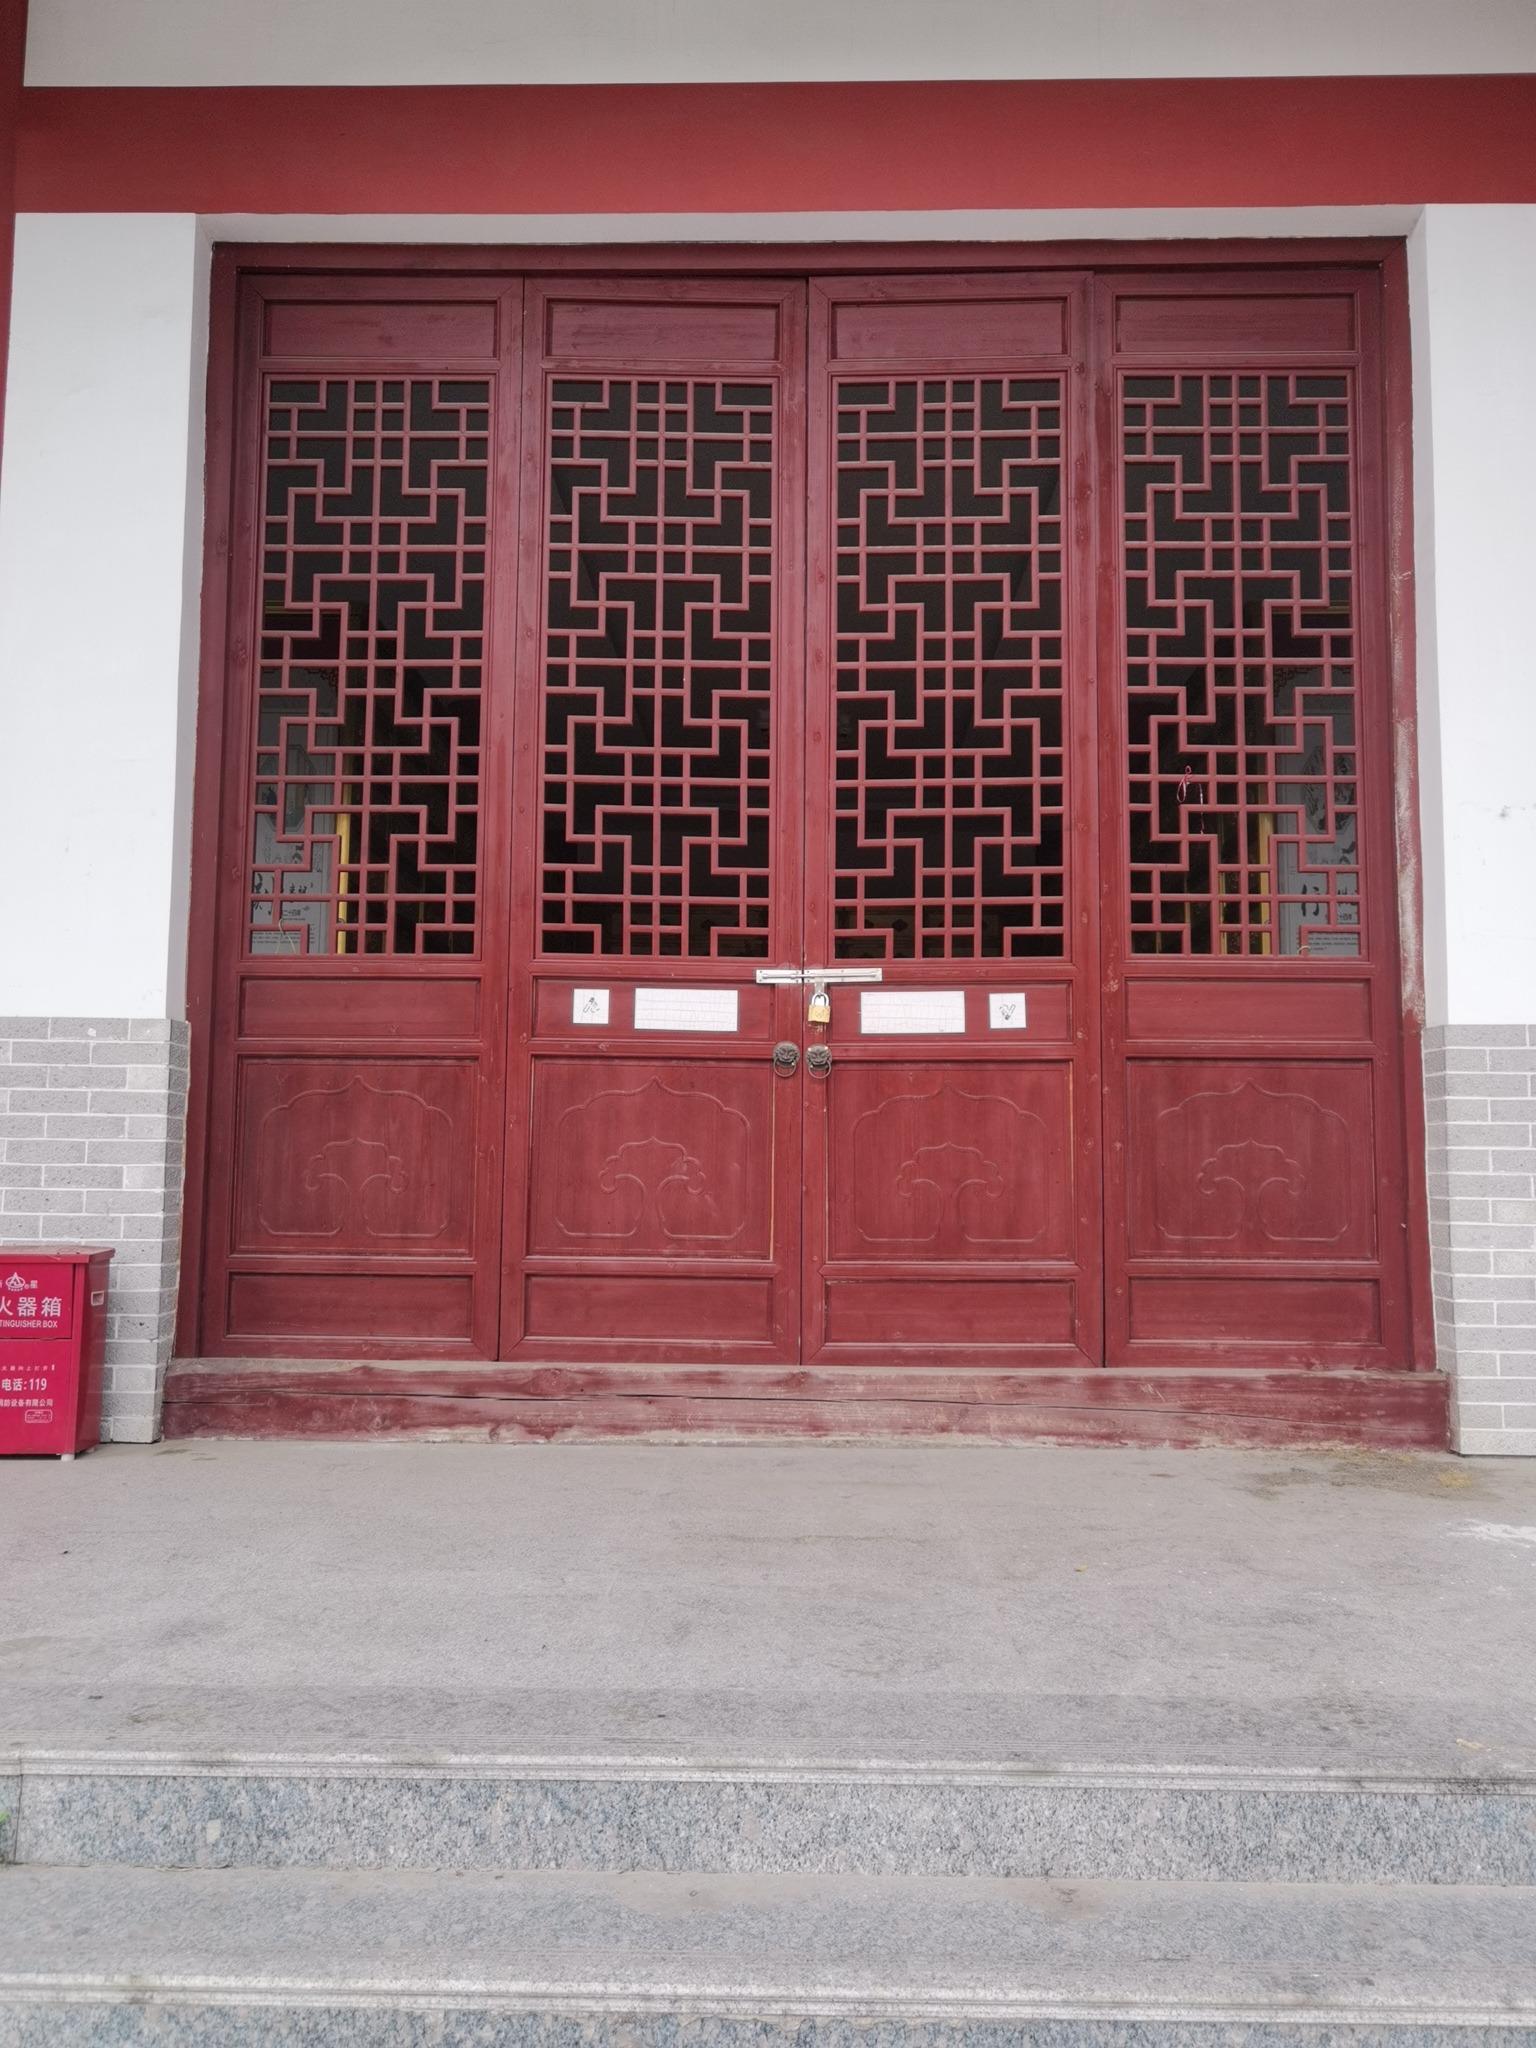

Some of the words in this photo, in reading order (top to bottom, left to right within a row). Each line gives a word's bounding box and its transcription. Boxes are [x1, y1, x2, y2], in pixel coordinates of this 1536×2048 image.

[0, 1296, 62, 1317] 火器箱
[42, 1320, 58, 1328] BOX
